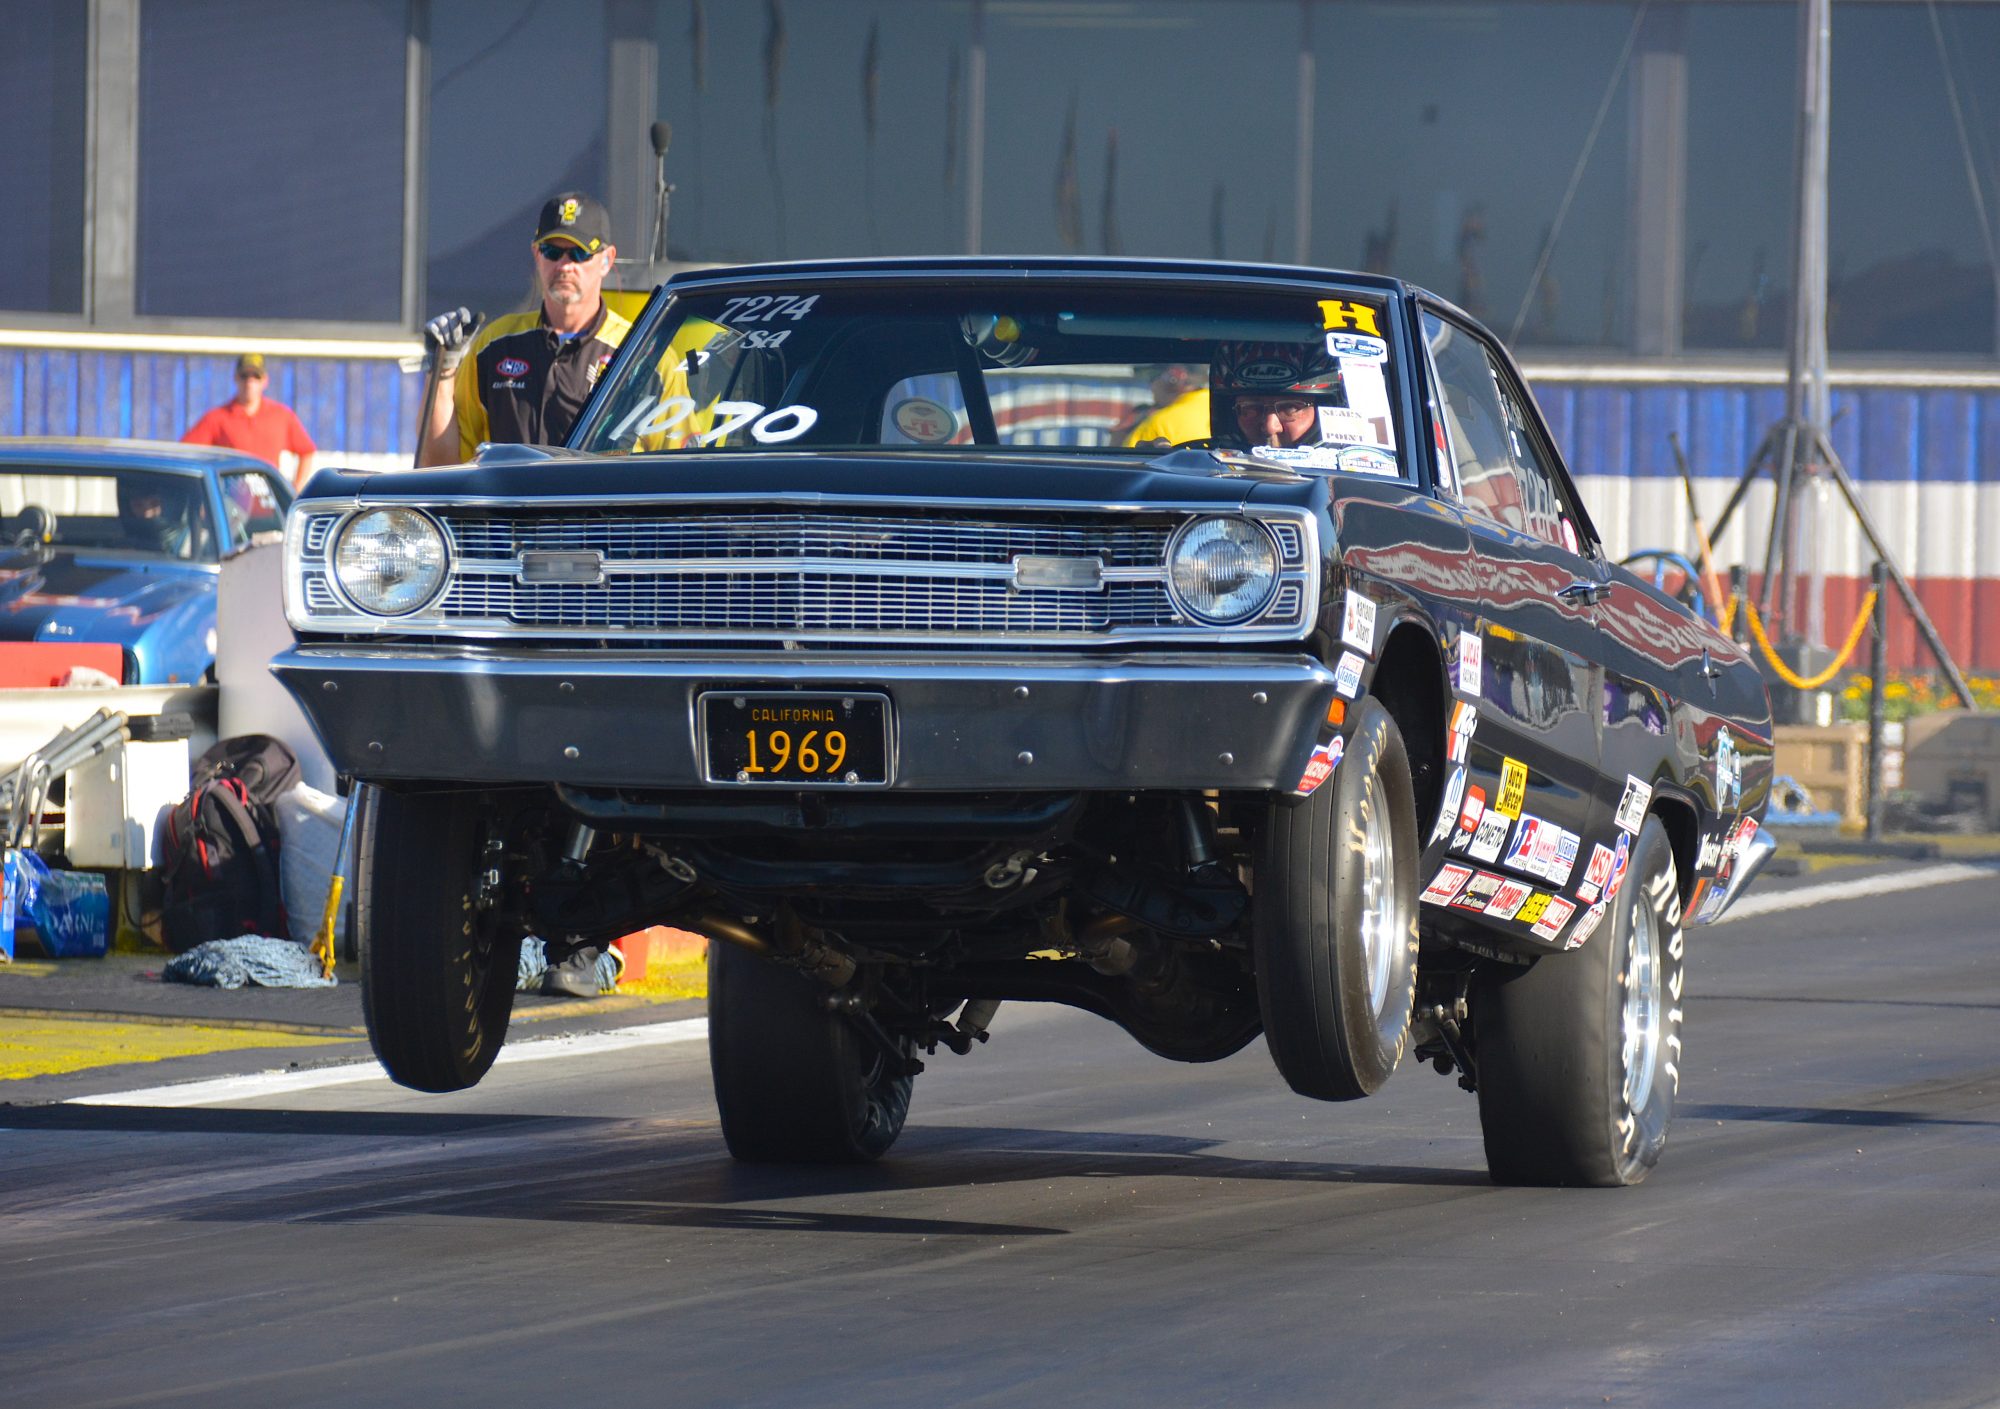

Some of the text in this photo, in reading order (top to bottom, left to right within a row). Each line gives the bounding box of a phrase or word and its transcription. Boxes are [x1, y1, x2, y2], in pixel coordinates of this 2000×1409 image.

[712, 294, 820, 325] 7274
[1317, 300, 1381, 337] H
[703, 329, 792, 355] E/SA
[1322, 409, 1363, 420] SEARS
[1326, 432, 1364, 443] POINT
[752, 709, 835, 722] CALIFORNIA
[743, 730, 847, 773] 1969
[1476, 820, 1507, 849] COMETIC
[1587, 847, 1613, 887] MSD
[1491, 884, 1523, 910] COMP
